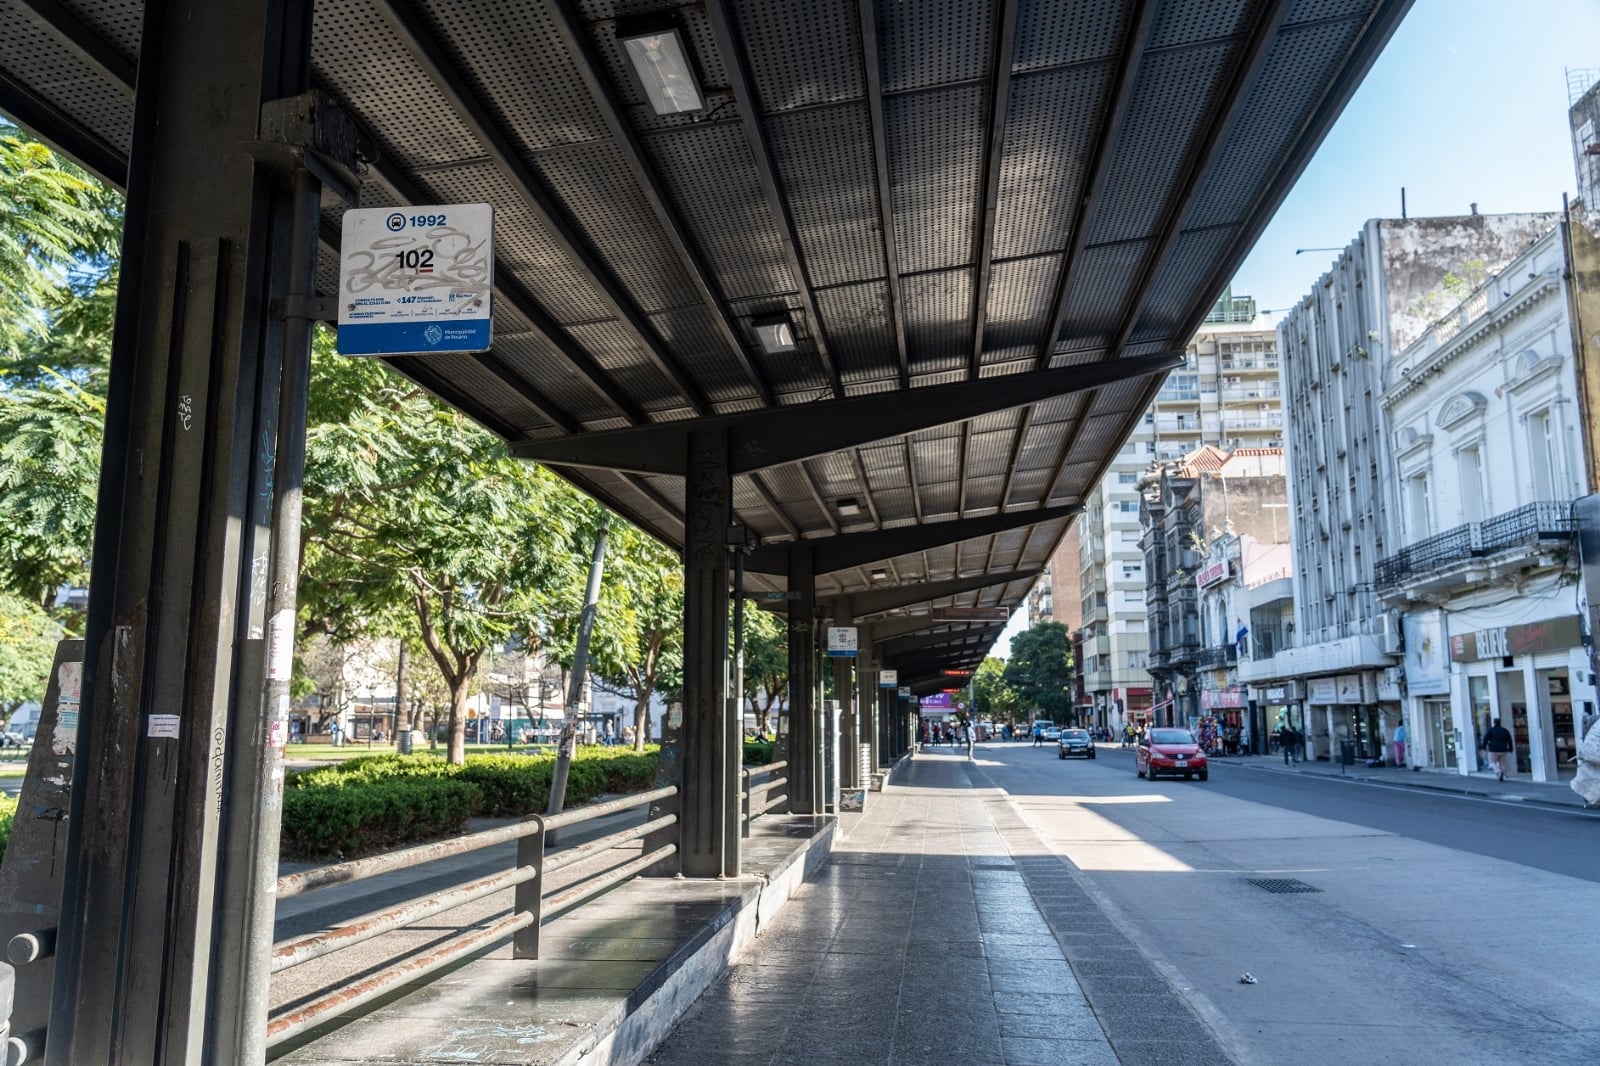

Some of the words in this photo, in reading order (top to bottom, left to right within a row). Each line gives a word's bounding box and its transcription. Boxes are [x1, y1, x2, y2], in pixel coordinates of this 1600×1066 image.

[409, 214, 447, 228] 1992
[396, 249, 434, 269] 102
[401, 296, 416, 304] 147
[444, 328, 477, 336] Municipalidad
[1475, 627, 1510, 660] BELIEVE
